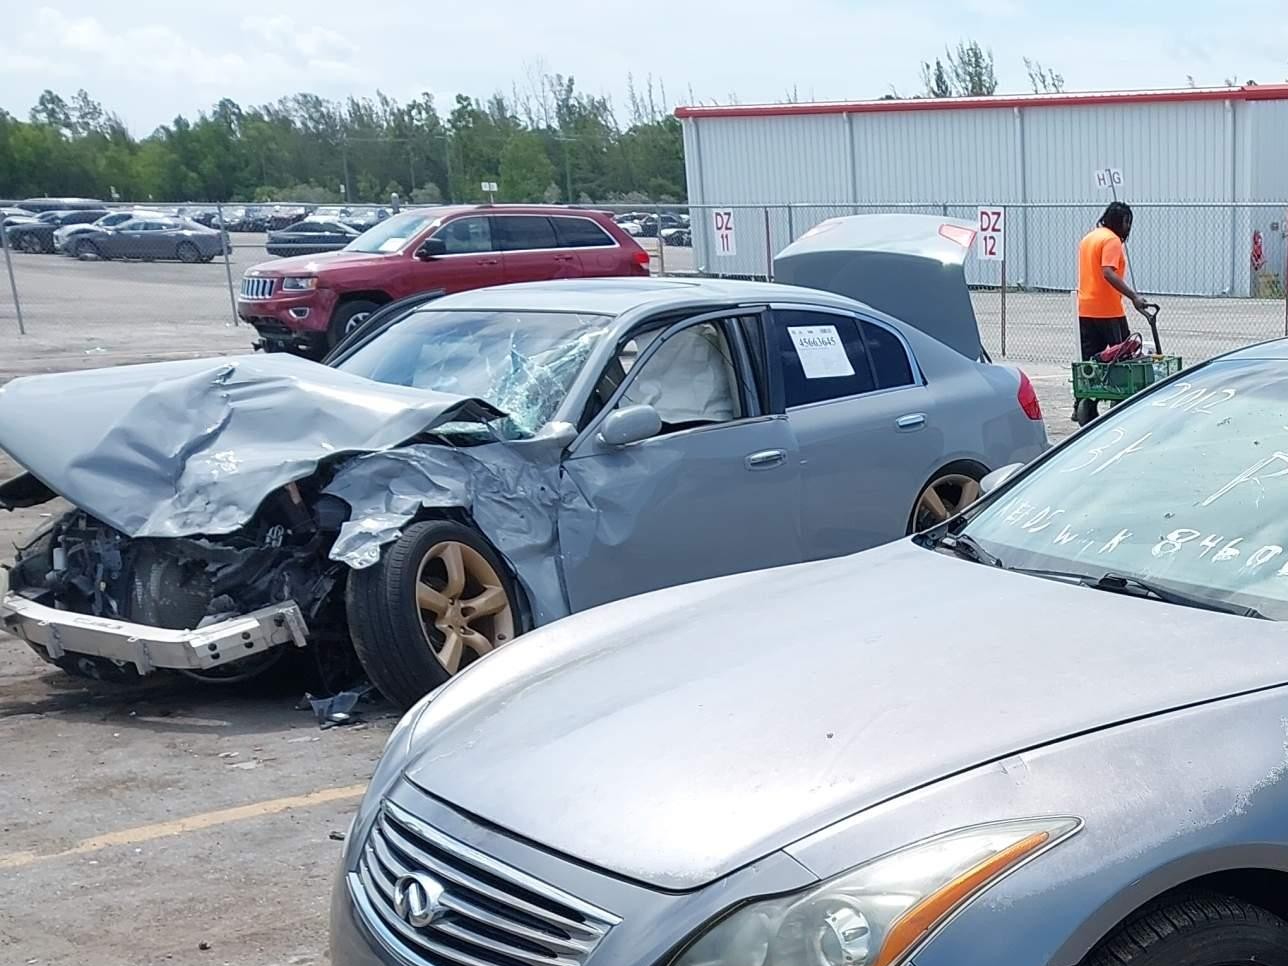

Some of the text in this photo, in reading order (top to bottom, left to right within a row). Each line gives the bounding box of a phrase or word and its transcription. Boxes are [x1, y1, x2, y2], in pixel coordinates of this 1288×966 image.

[1097, 171, 1122, 186] H G
[715, 211, 733, 231] DZ
[980, 211, 1002, 232] DZ
[720, 233, 730, 252] 11
[983, 235, 997, 256] 12
